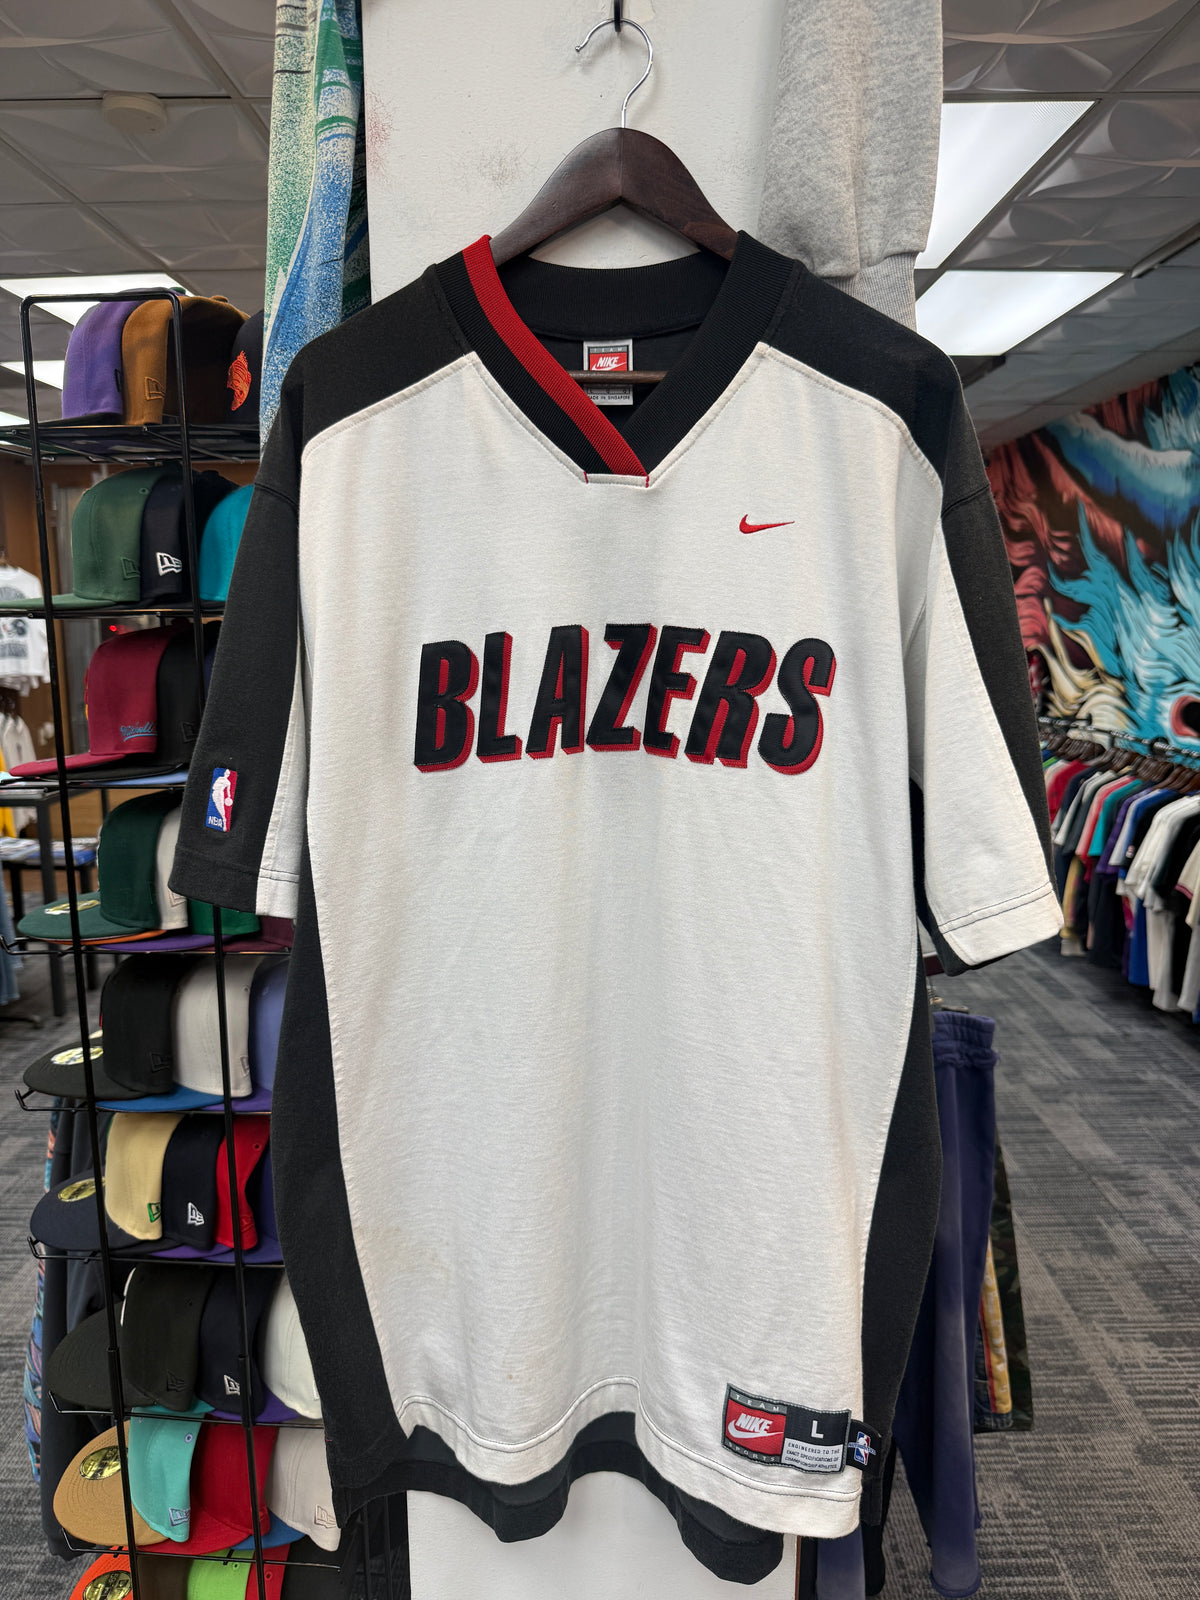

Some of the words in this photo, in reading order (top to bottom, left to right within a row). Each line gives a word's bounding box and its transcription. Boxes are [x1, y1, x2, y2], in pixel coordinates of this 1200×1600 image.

[596, 356, 620, 368] NIKE
[414, 623, 837, 775] BLAZERS
[208, 815, 223, 828] NBA
[735, 1412, 774, 1434] NIKE
[810, 1420, 824, 1439] L
[788, 1442, 821, 1455] ENGINEERED
